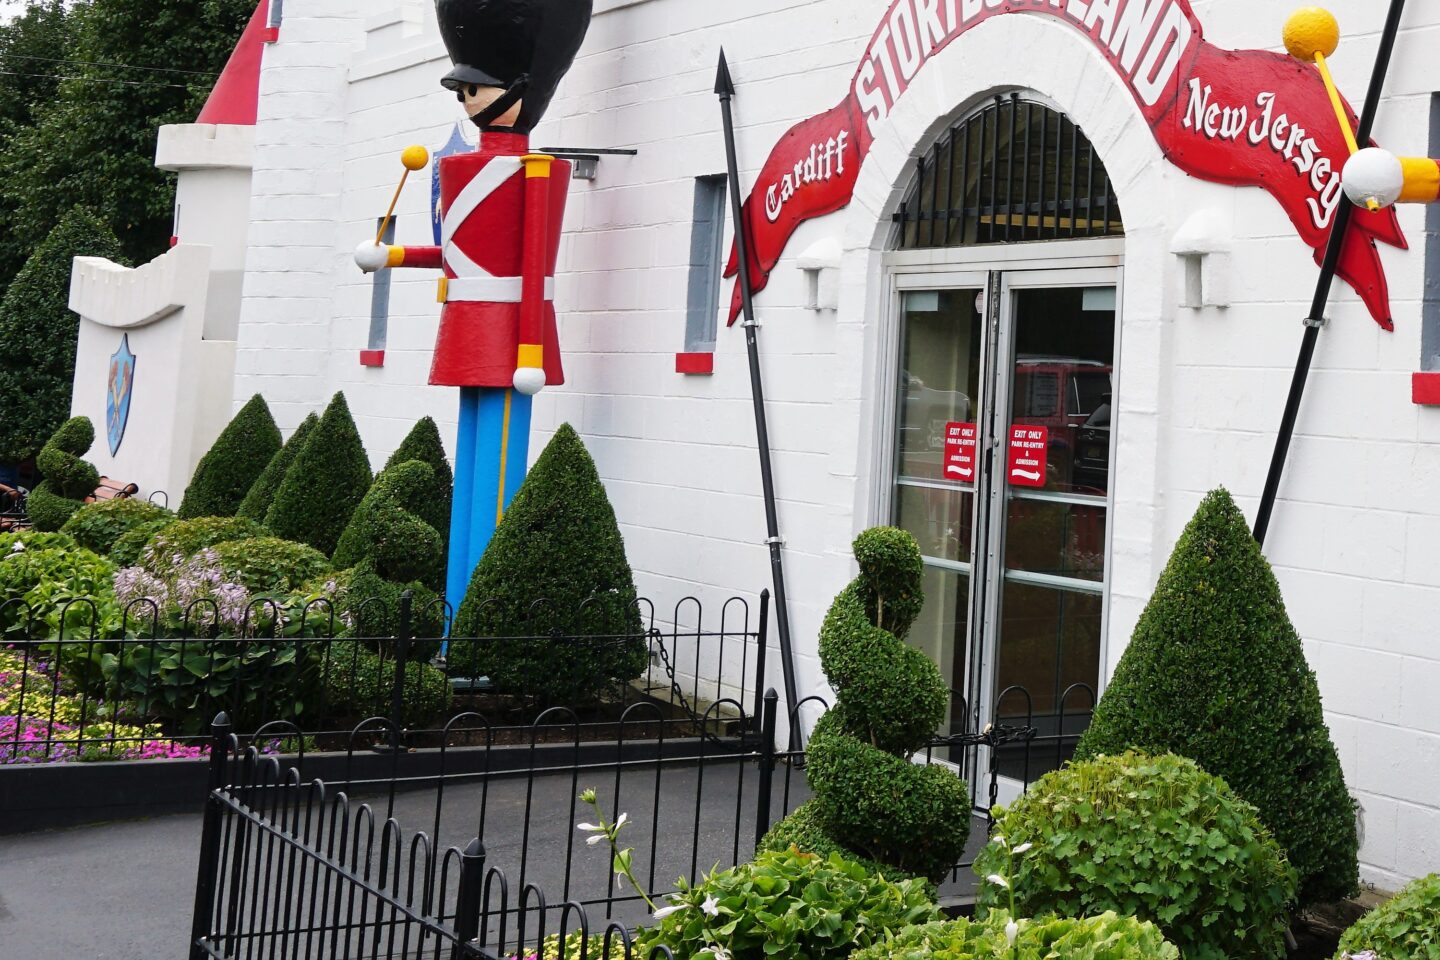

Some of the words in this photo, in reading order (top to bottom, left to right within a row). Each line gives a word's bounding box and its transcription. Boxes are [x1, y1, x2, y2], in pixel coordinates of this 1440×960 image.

[764, 130, 849, 222] Cardiff
[1183, 77, 1247, 140] New
[1248, 92, 1342, 229] Jersey
[950, 428, 960, 436] EXIT
[1014, 430, 1026, 438] EXIT
[1028, 431, 1042, 439] ONLY
